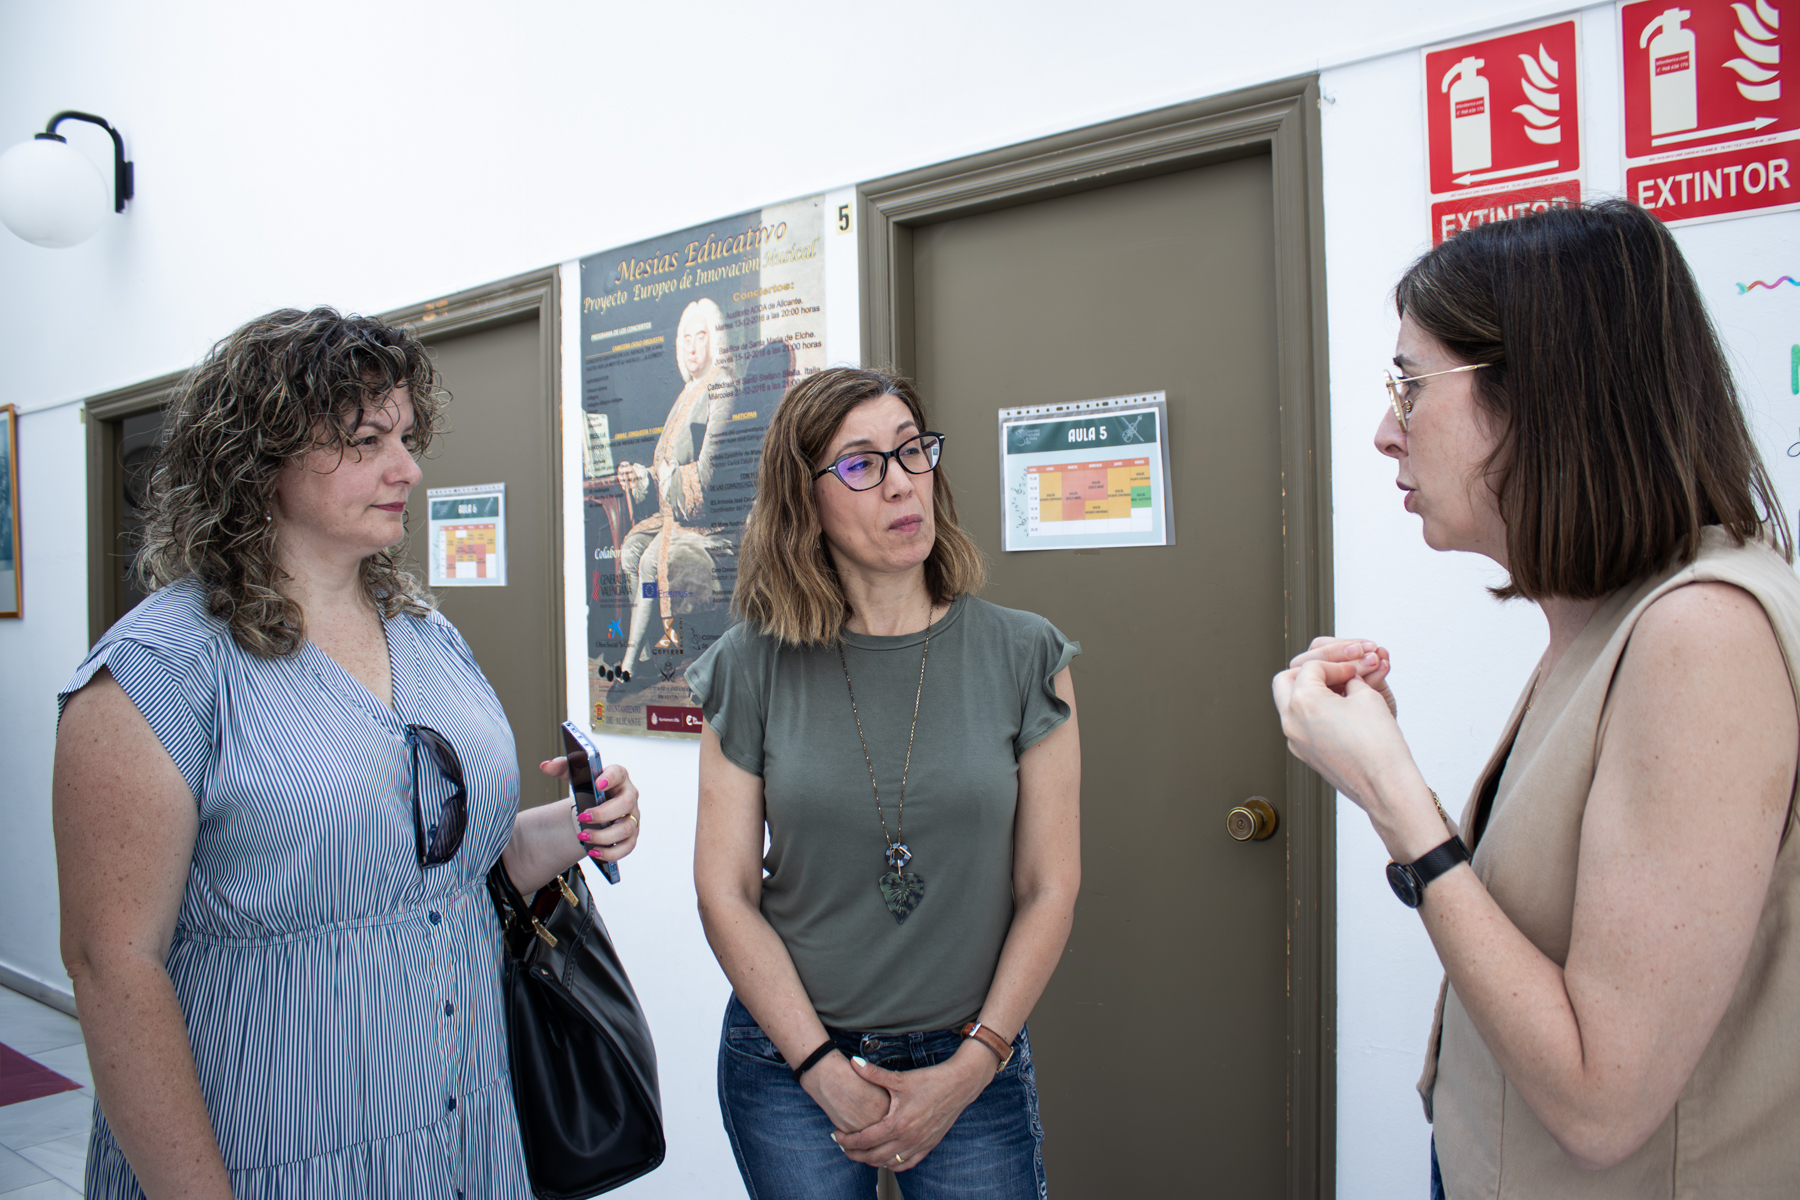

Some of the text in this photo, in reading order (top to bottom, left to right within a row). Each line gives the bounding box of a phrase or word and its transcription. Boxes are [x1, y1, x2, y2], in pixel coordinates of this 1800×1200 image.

[1638, 158, 1790, 210] EXTINTOR
[838, 204, 850, 231] 5
[684, 220, 787, 267] Educativo
[583, 237, 820, 315] Proyecto Europeo de Innovación Musical
[732, 282, 795, 302] Conciertos:
[725, 308, 749, 320] Auditorio
[767, 302, 776, 310] de
[776, 297, 804, 308] Alicante.
[715, 322, 733, 332] Martes
[734, 314, 765, 327] 13-12-2016
[770, 311, 780, 319] las
[780, 307, 800, 317] 20:00
[800, 305, 820, 314] horas
[740, 342, 748, 350] de
[748, 340, 765, 349] Santa
[794, 331, 816, 340] Elche.
[714, 355, 733, 365] Jueves
[734, 348, 766, 361] 15-12-2016
[771, 346, 781, 354] las
[782, 342, 801, 352] 21:00
[802, 340, 822, 350] horas
[759, 371, 781, 382] Stefano
[771, 382, 781, 390] las
[1067, 425, 1108, 443] AULA 5
[458, 504, 472, 514] AULA
[658, 588, 694, 599] Erasmus+
[606, 704, 641, 714] AYUNTAMIENTO
[606, 716, 641, 727] DE ALICANTE
